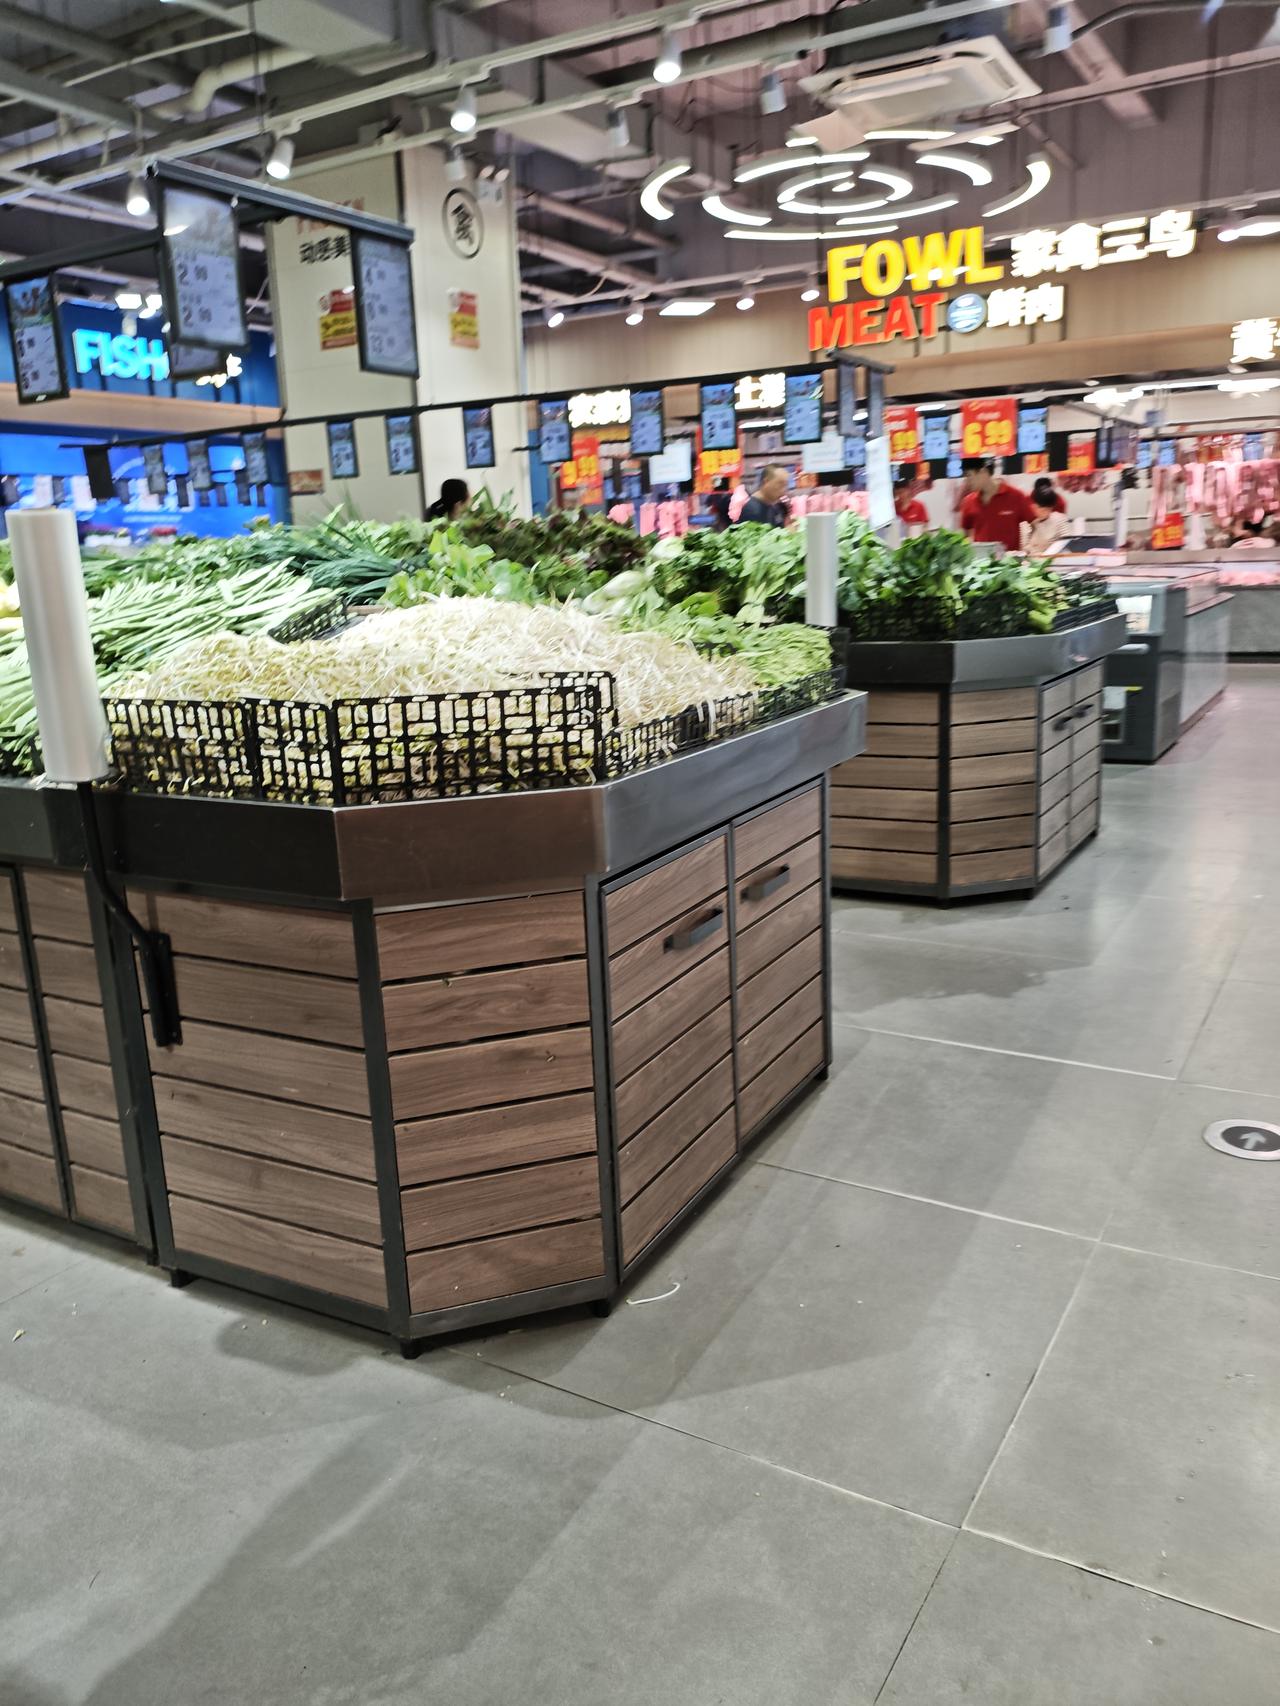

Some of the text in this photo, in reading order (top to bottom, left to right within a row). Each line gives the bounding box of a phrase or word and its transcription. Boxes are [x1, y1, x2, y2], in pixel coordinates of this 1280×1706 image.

[827, 226, 1004, 301] FOWL
[808, 292, 948, 351] MEAT
[73, 328, 170, 381] FISH
